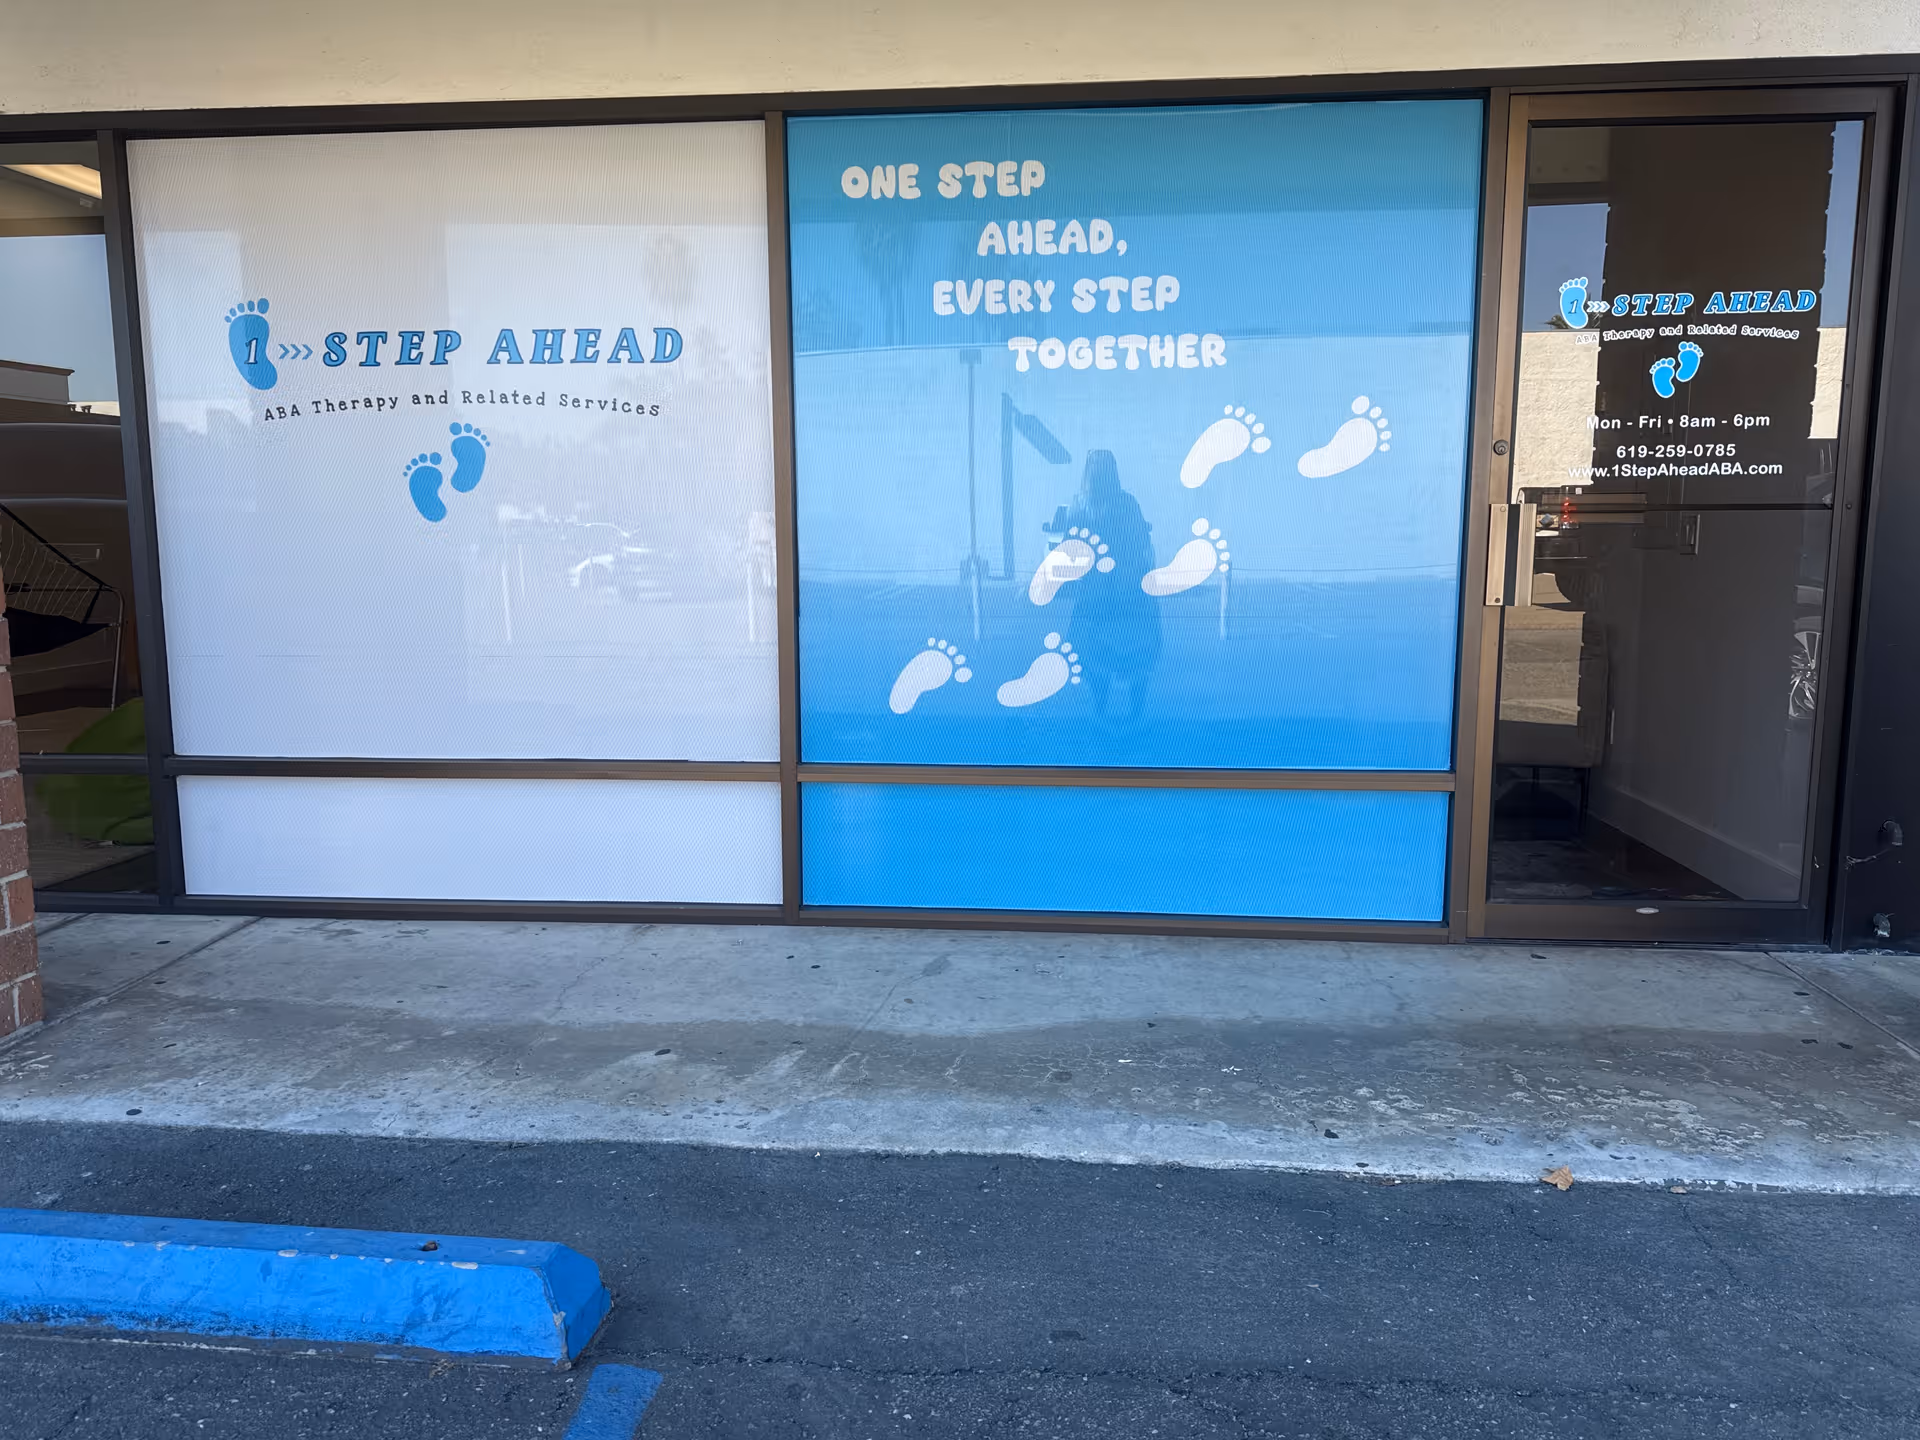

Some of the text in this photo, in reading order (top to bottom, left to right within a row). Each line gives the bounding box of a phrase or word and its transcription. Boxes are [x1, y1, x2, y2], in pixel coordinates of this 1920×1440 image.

[840, 160, 1046, 200] ONE STEP
[976, 218, 1128, 257] AHEAD,
[932, 275, 1180, 316] EVERY STEP
[1568, 290, 1817, 316] 1 STEP AHEAD
[243, 327, 684, 367] 1 STEP AHEAD
[1575, 324, 1800, 345] ABA Therapy and Related Services
[1007, 333, 1228, 372] TOGETHER
[264, 389, 661, 422] ABA Therapy and Related Services
[1586, 415, 1621, 430] Mon
[1638, 415, 1662, 429] Fri
[1679, 414, 1716, 428] 8am
[1733, 413, 1771, 430] 6pm
[1616, 444, 1736, 459] 619-259-0785
[1568, 462, 1783, 479] www.1StepAheadABA.com
